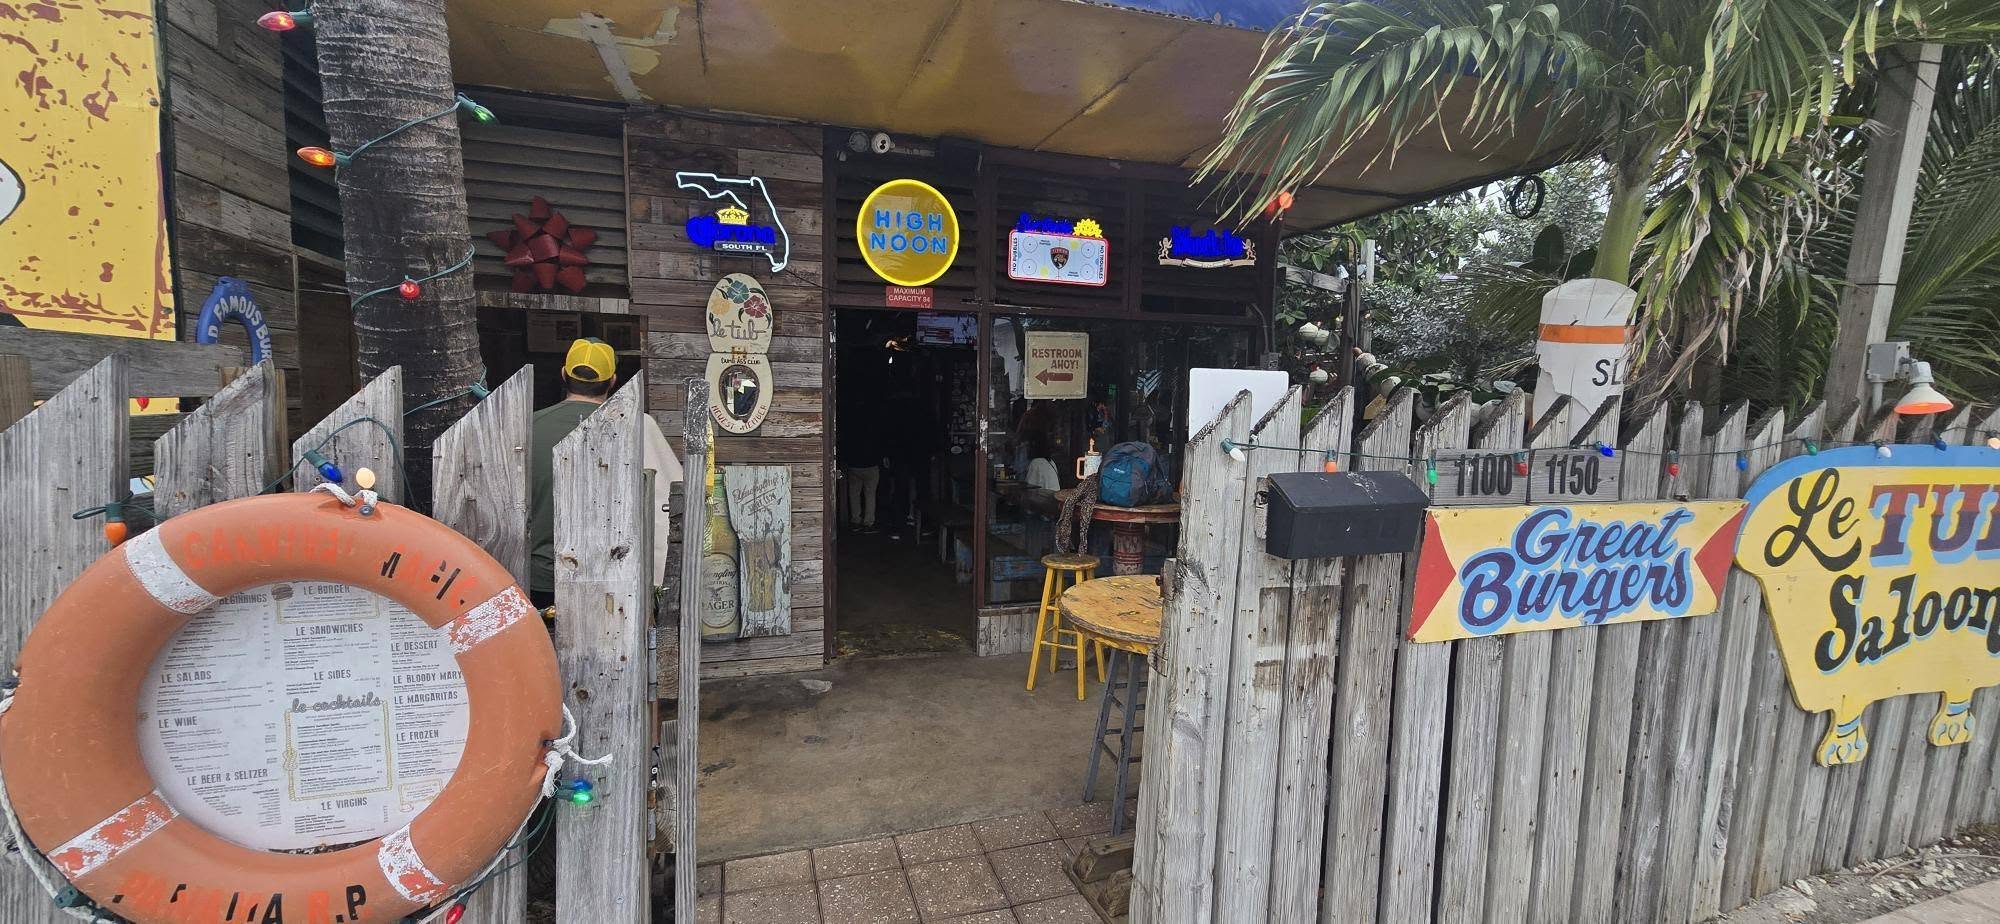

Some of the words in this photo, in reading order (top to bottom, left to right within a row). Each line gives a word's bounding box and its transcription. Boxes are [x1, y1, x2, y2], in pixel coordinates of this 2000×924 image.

[875, 210, 942, 232] HIGH
[722, 243, 753, 251] SOUTH
[870, 232, 947, 254] NOON
[213, 296, 262, 327] FAMOUS
[710, 318, 727, 338] le
[725, 319, 767, 341] tub
[1031, 348, 1082, 359] RESTROOM
[1050, 360, 1079, 370] AHOY!
[711, 404, 735, 430] NEWEST
[1455, 452, 1513, 496] 1100
[1546, 453, 1599, 496] 1150
[1764, 467, 1862, 572] Le
[1516, 508, 1692, 566] Great
[303, 585, 315, 596] LE
[1460, 548, 1692, 626] Burgers
[296, 626, 307, 636] LE
[310, 623, 364, 635] SANDWICHES
[391, 643, 401, 652] LE
[404, 640, 438, 651] DESSERT
[161, 674, 172, 684] LE
[176, 671, 212, 682] SALADS
[314, 671, 324, 681] LE
[328, 669, 352, 680] SIDES
[393, 675, 403, 684] LE
[406, 673, 437, 683] BLOODY
[440, 670, 463, 681] MARY
[292, 698, 308, 713] le
[312, 691, 381, 712] cocktails
[394, 695, 404, 705] LE
[407, 691, 458, 703] MARGARITAS
[158, 719, 169, 729] LE
[174, 716, 198, 727] WINE
[396, 732, 406, 741] LE
[409, 729, 439, 740] FROZEN
[187, 776, 197, 786] LE
[201, 773, 221, 784] BEER
[225, 772, 231, 781] &
[234, 769, 268, 780] SELTZER
[321, 801, 332, 811] LE
[336, 797, 368, 809] VIRGINS
